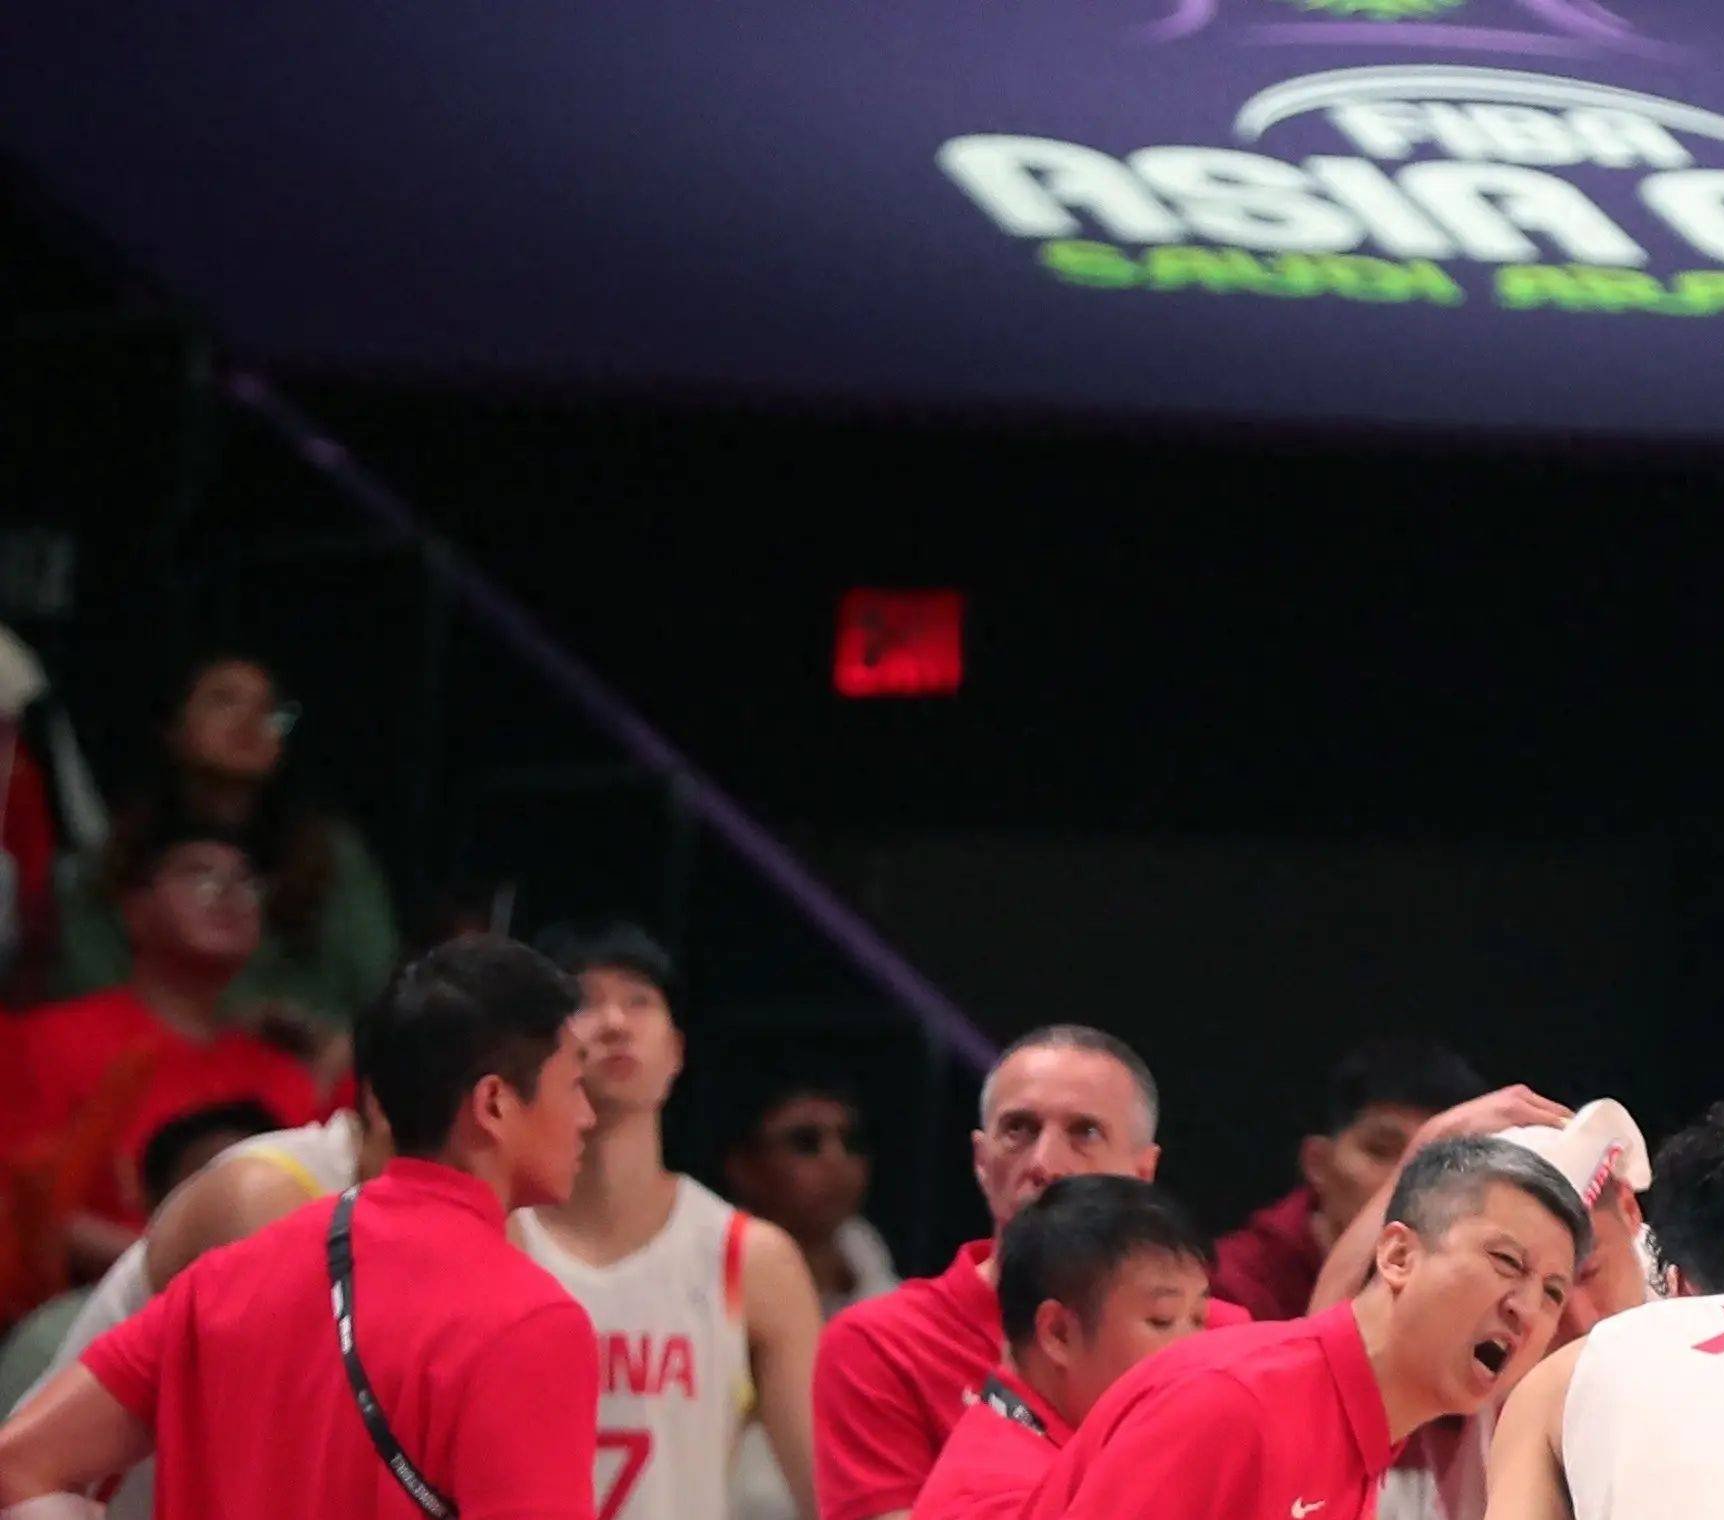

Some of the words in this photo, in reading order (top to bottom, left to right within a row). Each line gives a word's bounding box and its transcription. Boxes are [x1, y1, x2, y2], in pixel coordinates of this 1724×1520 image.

[1327, 101, 1697, 168] FIBA
[940, 132, 1648, 266] ASIA
[1041, 239, 1464, 302] SAUDI
